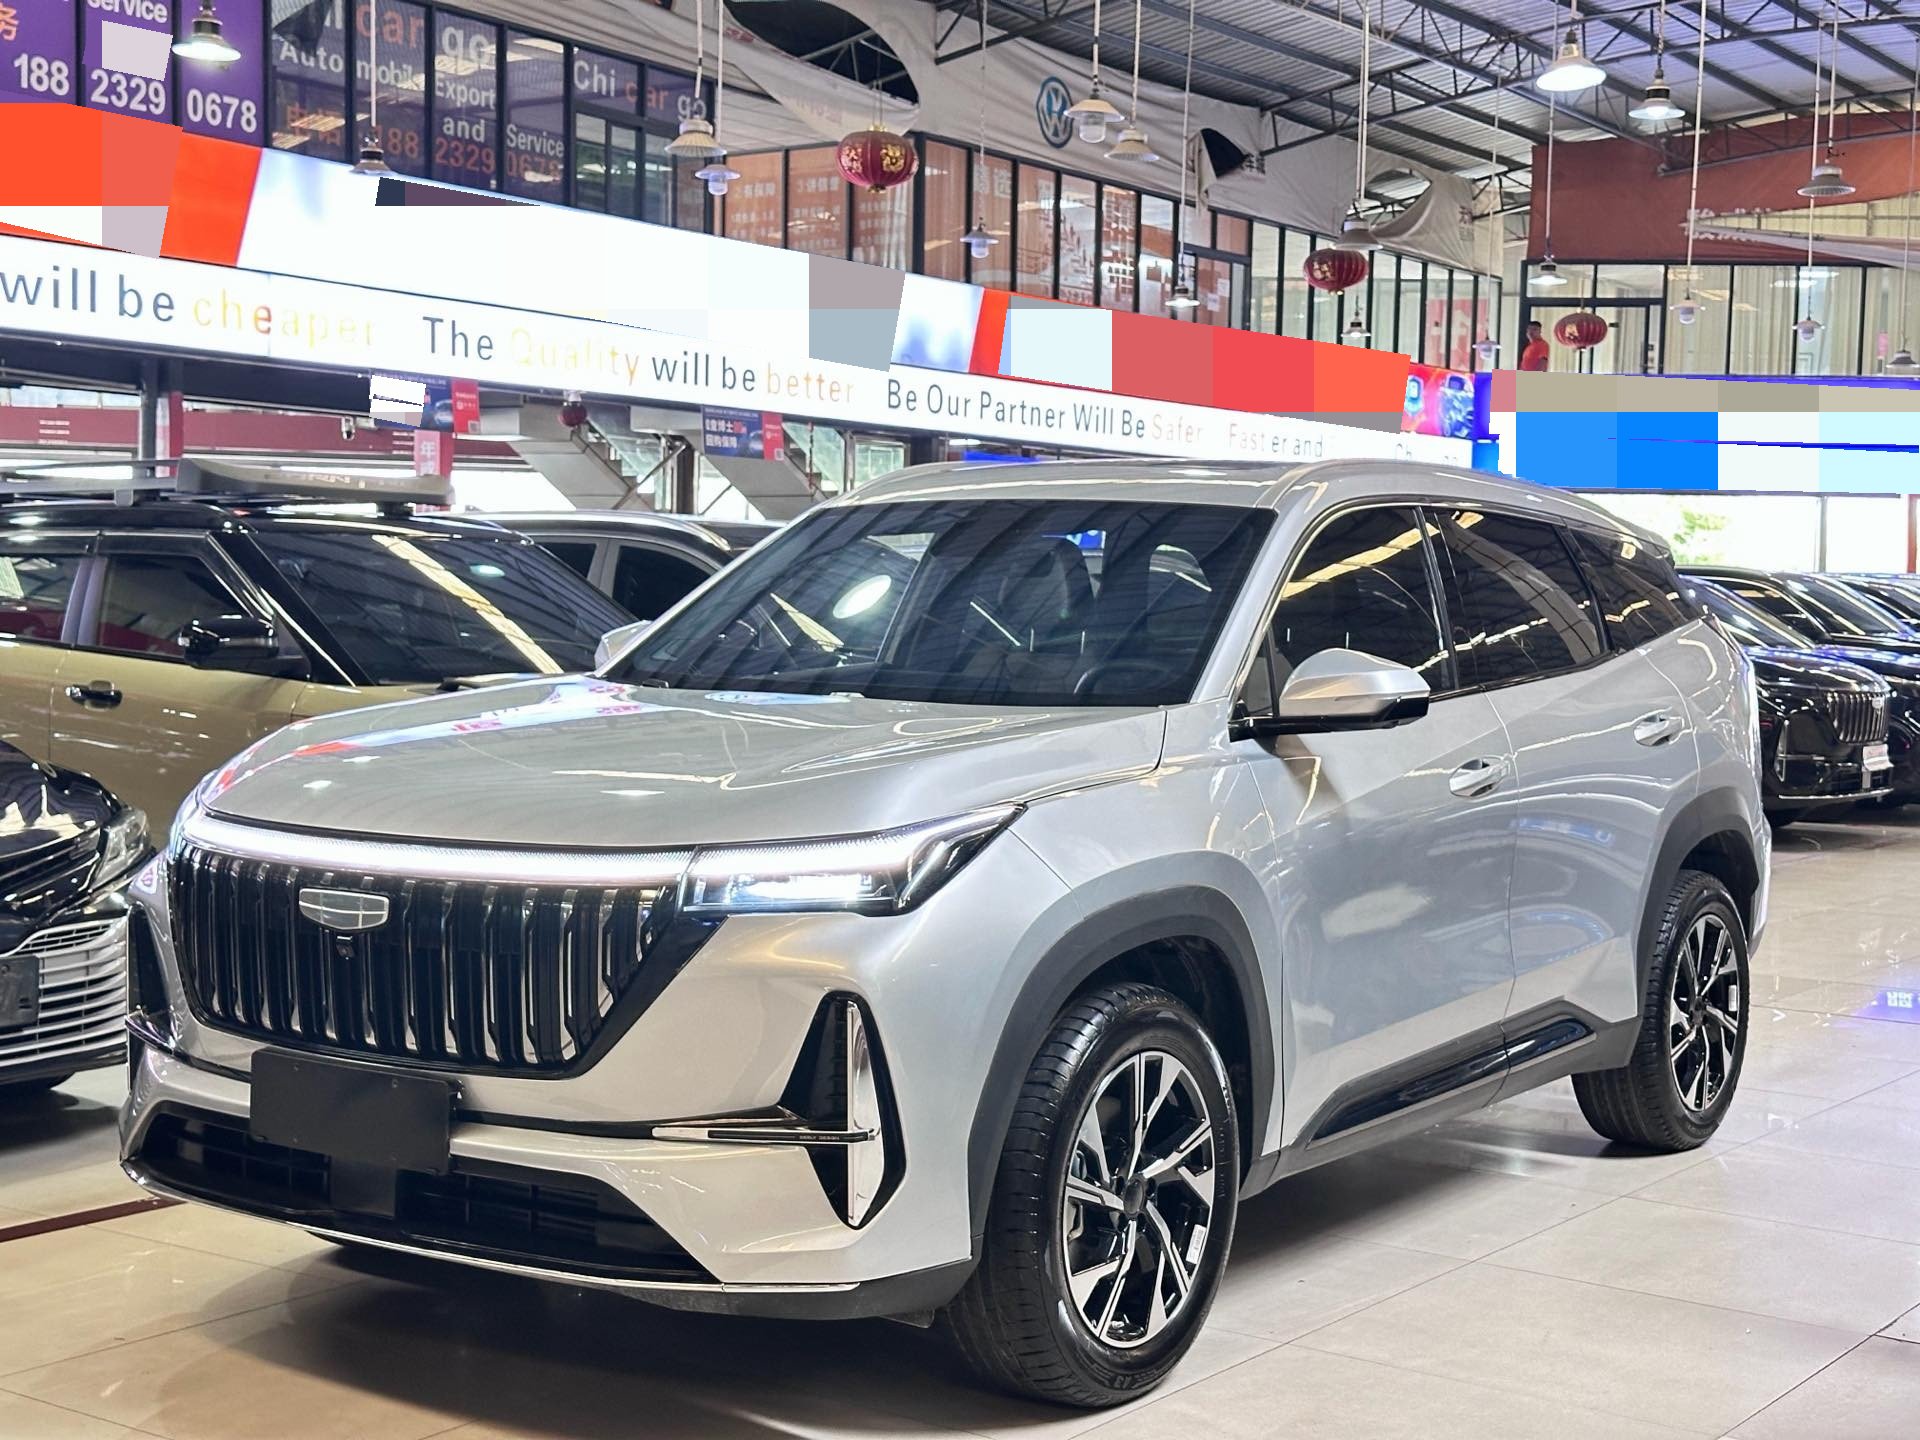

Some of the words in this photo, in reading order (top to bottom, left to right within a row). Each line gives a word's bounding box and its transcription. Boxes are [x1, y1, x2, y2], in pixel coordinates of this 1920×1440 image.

[356, 3, 425, 48] car
[14, 53, 70, 96] 188
[91, 69, 166, 115] 2329
[186, 88, 257, 133] 0678
[279, 39, 343, 73] Auto
[435, 73, 496, 110] Export
[573, 60, 616, 97] Chi
[435, 138, 496, 174] 2329
[442, 117, 486, 143] and
[506, 123, 564, 158] Service
[0, 264, 97, 312] will
[118, 274, 174, 322] be
[193, 288, 375, 349] cheaper
[422, 316, 494, 361] The
[511, 327, 639, 387] Quality
[652, 350, 710, 387] will
[722, 356, 756, 392] be
[767, 362, 855, 404] better
[887, 378, 917, 411] Be
[926, 384, 971, 418] Our
[979, 391, 1066, 430] Partner
[1073, 402, 1114, 435] Will
[1121, 410, 1146, 438] Be
[1151, 414, 1204, 443] Safer
[1292, 434, 1325, 457] and
